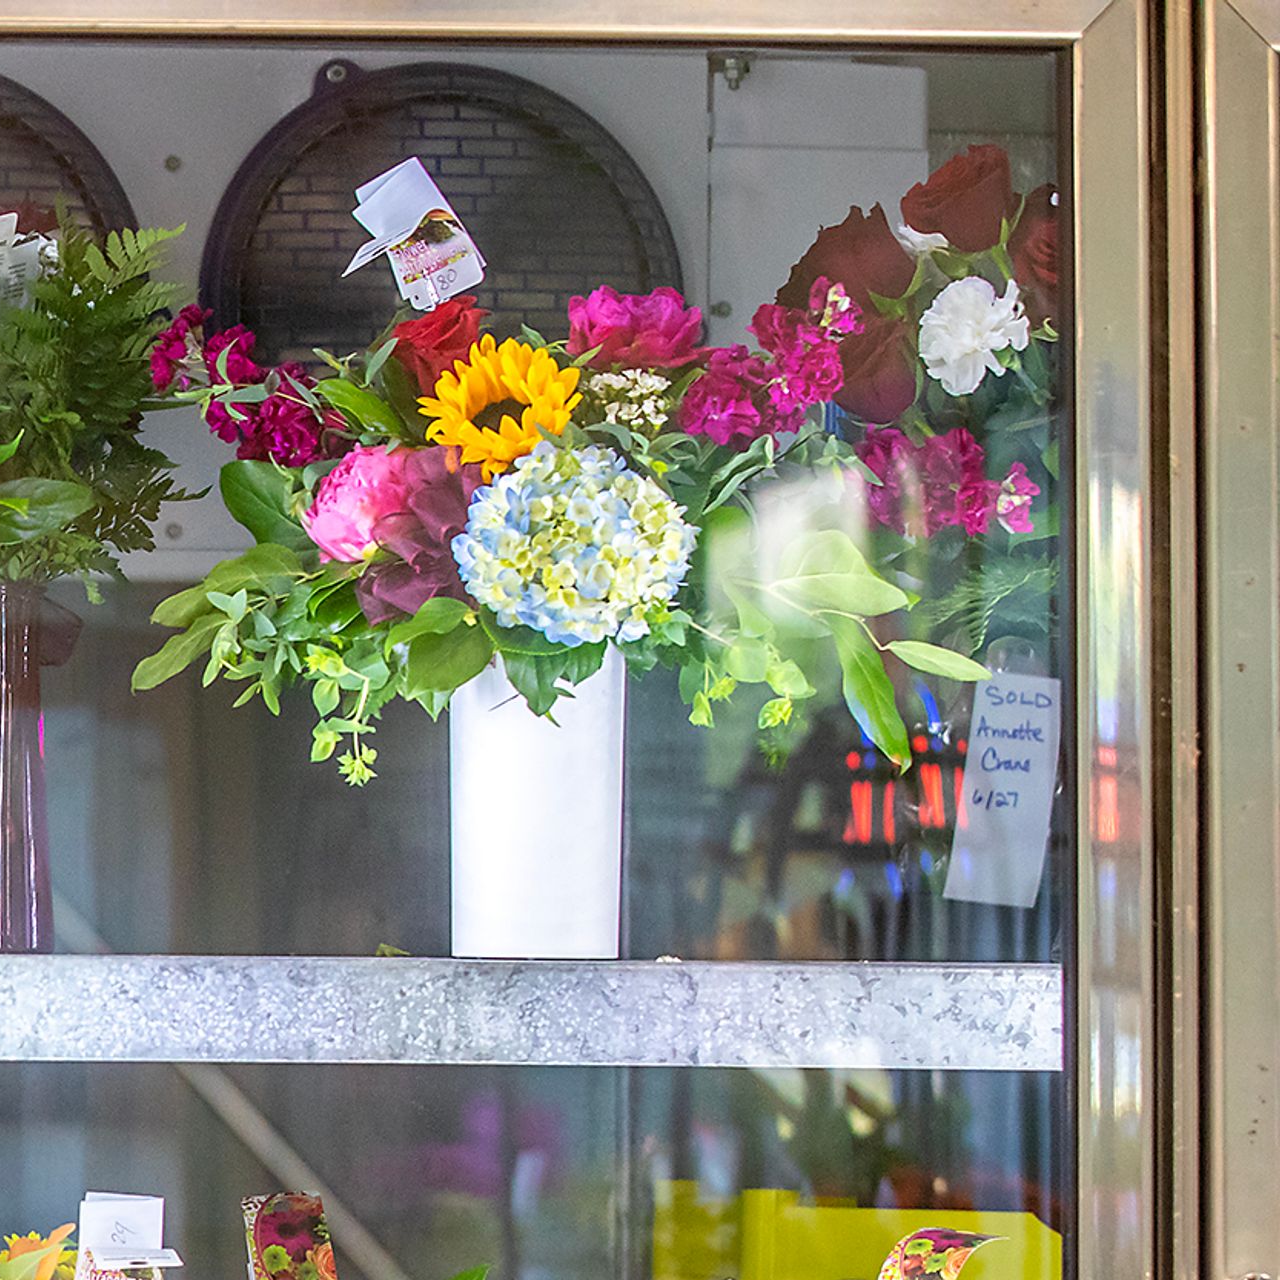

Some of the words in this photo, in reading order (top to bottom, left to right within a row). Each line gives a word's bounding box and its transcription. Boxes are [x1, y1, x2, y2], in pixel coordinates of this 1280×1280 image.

[437, 268, 457, 290] 80
[985, 685, 1052, 708] SOLD
[976, 715, 1044, 742] Annette
[972, 789, 1018, 810] 6/27
